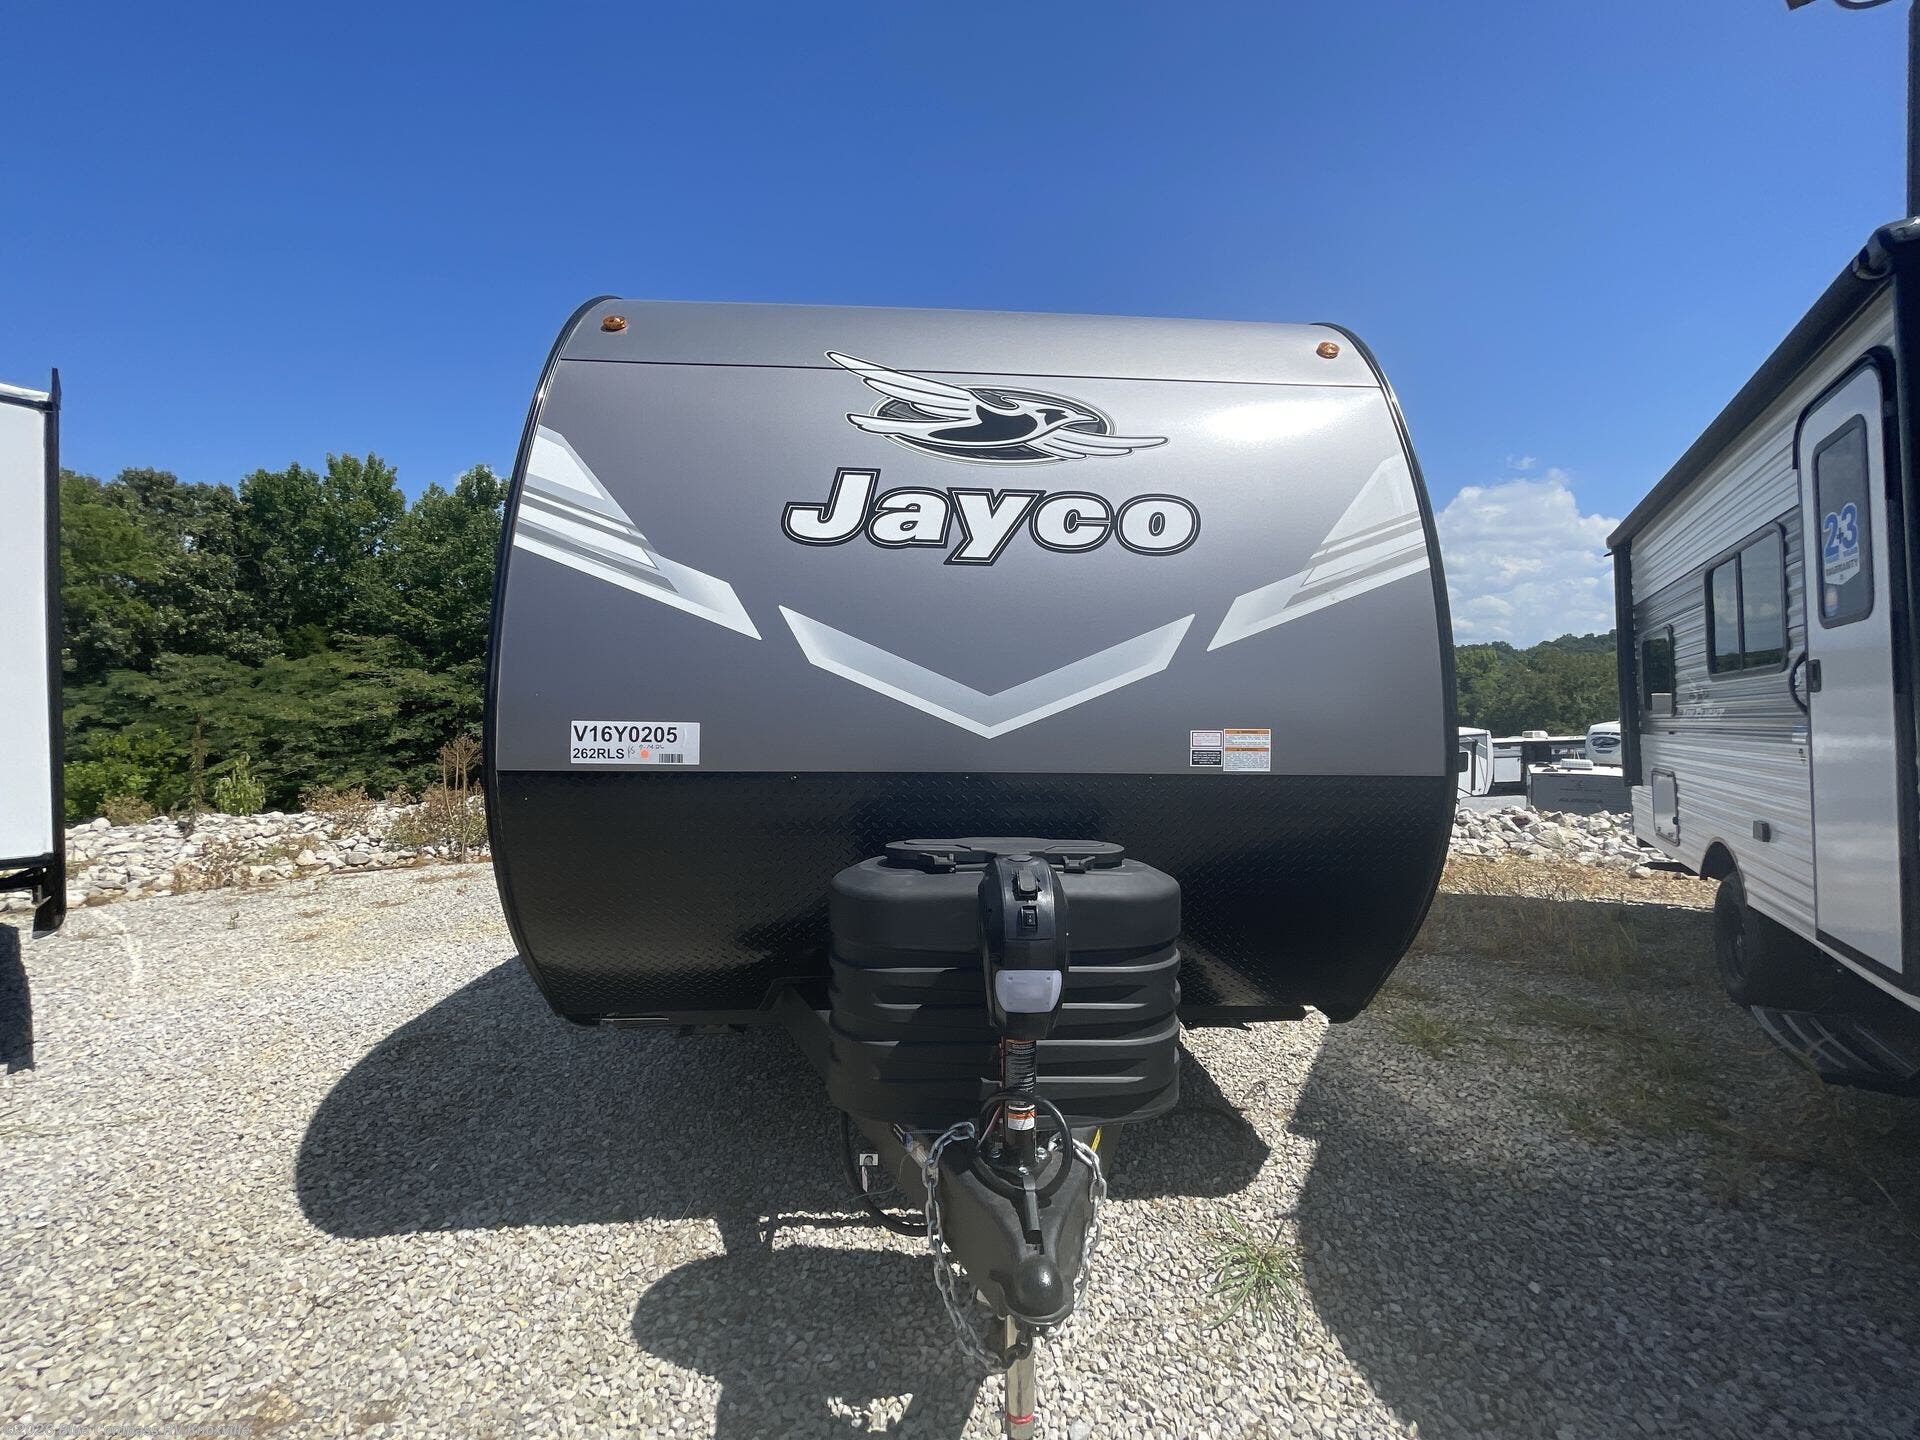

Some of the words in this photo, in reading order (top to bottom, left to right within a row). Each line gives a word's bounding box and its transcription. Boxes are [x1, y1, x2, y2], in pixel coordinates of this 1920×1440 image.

[781, 467, 1201, 566] Jayco
[573, 725, 678, 743] V16Y0205
[572, 748, 625, 759] 262RLS
